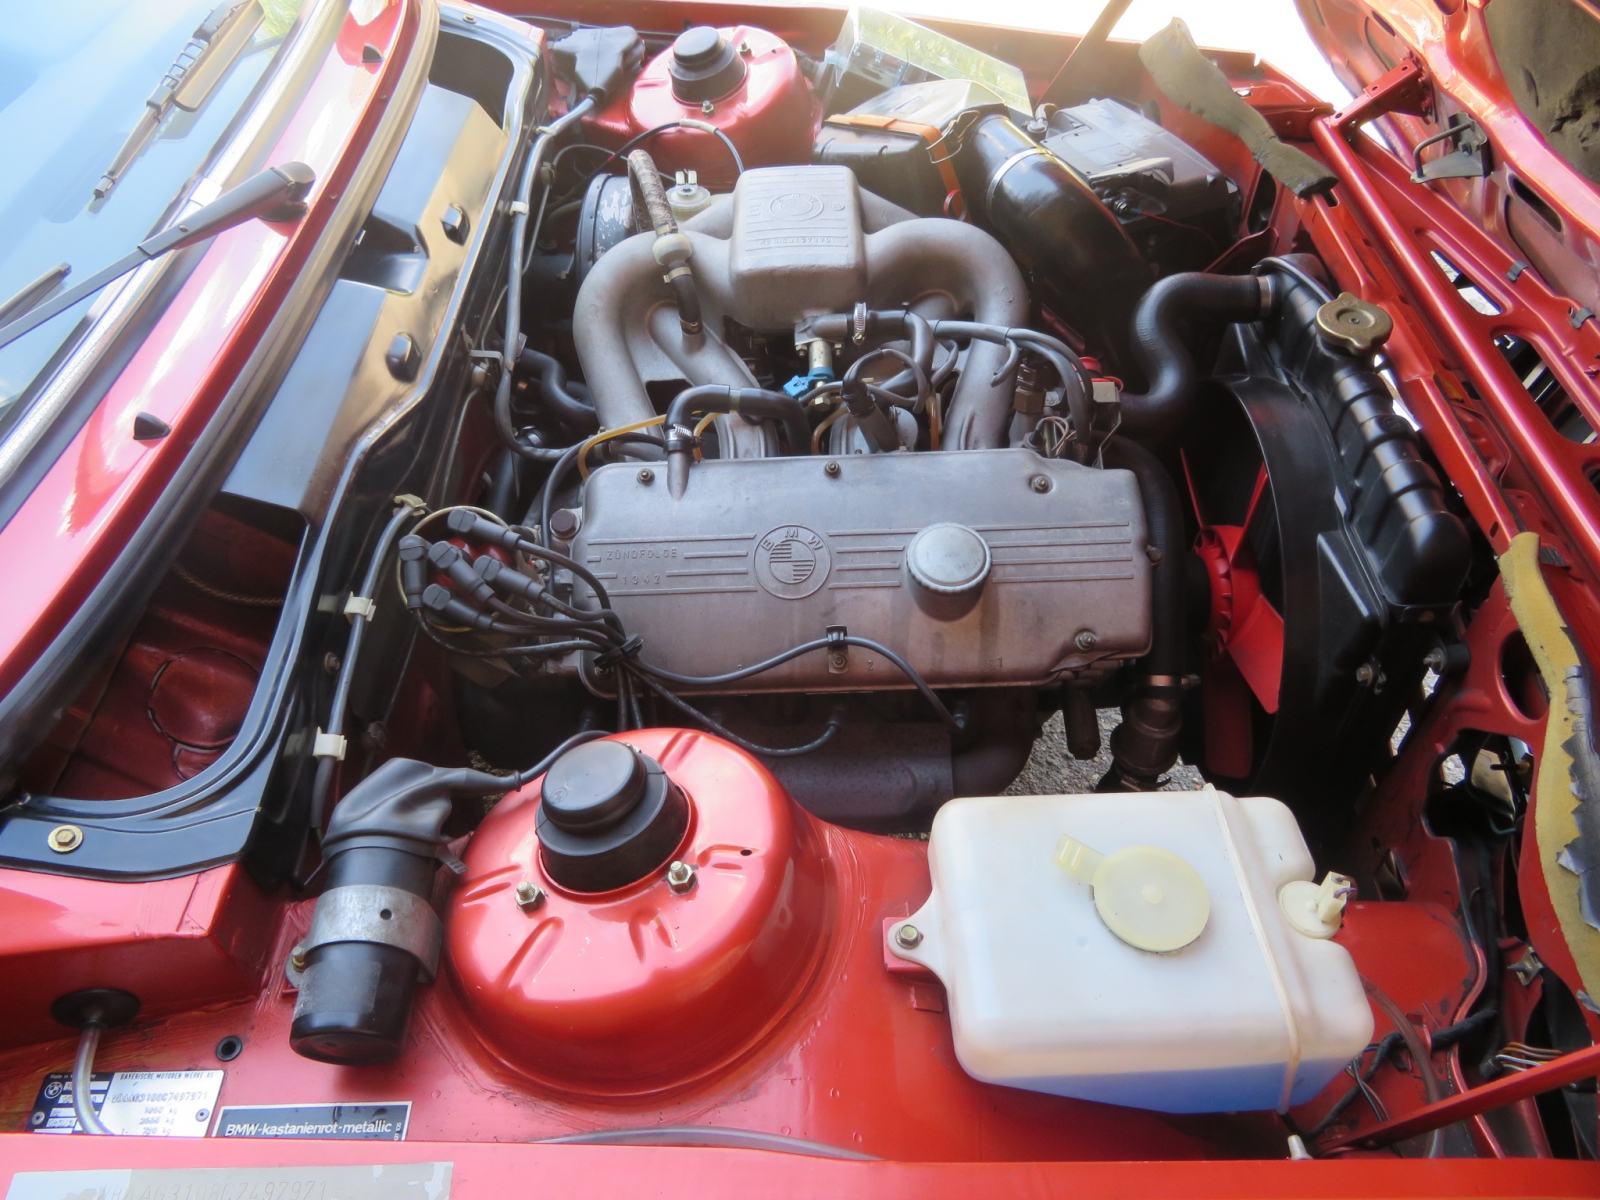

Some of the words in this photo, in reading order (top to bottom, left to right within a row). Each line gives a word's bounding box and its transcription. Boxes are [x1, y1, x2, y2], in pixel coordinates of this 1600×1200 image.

[760, 527, 823, 551] BMW
[156, 1072, 182, 1080] MOTOREN
[225, 1120, 392, 1137] BMW-kastanienrot-metallic
